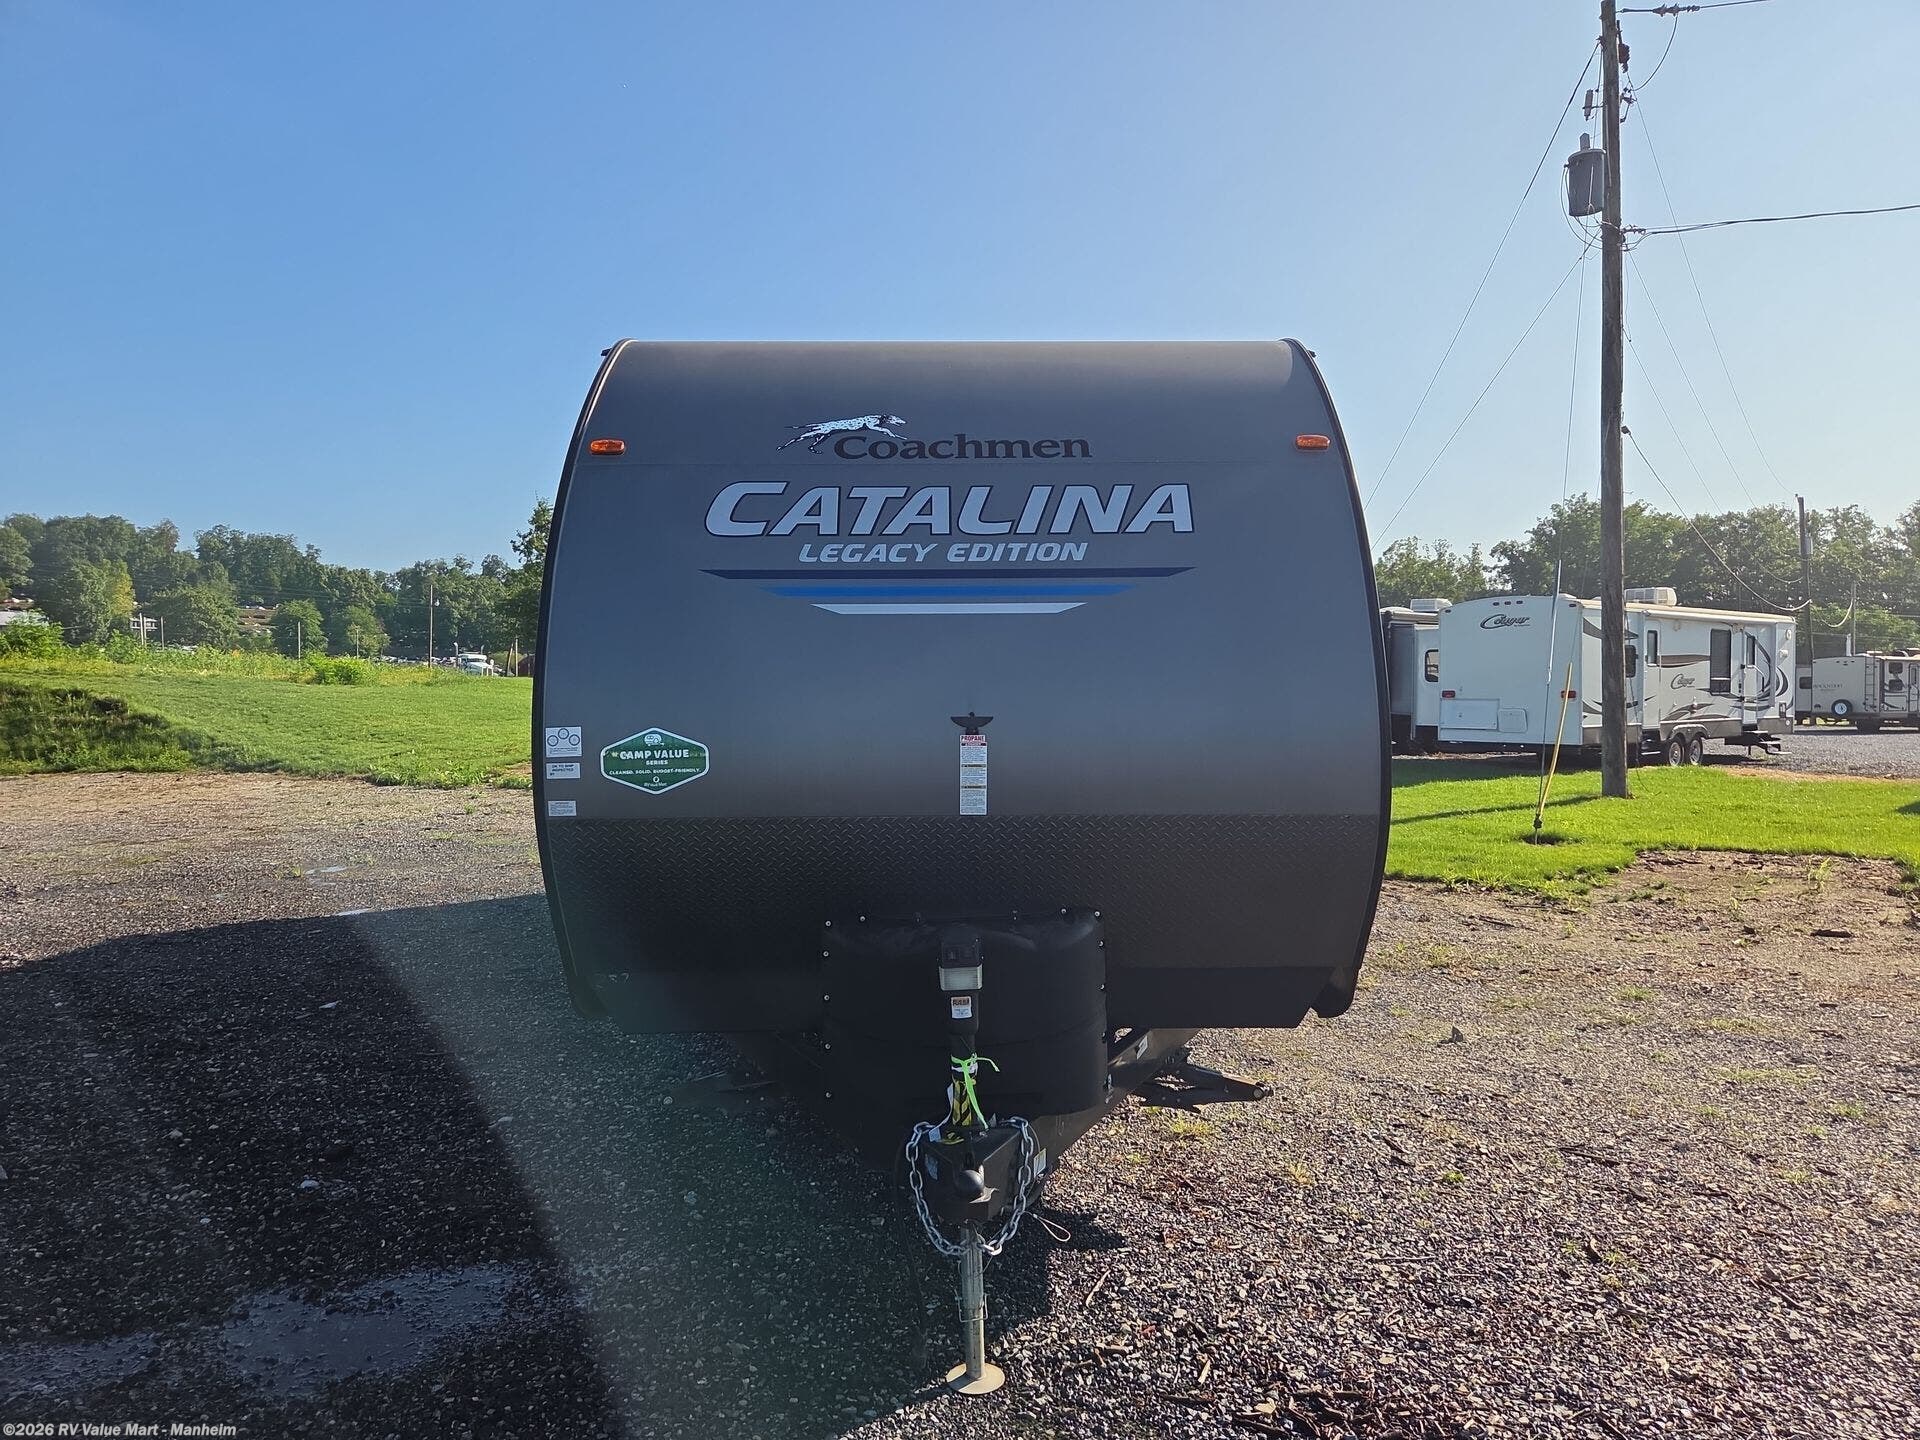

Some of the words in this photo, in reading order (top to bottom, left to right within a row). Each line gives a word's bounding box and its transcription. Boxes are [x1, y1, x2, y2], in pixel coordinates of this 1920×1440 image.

[833, 433, 1092, 460] Coachmen
[704, 481, 1196, 538] CATALINA
[798, 543, 937, 563] LEGACY
[947, 542, 1088, 563] EDITION
[619, 750, 652, 760] CAMP
[653, 749, 690, 759] VALUE
